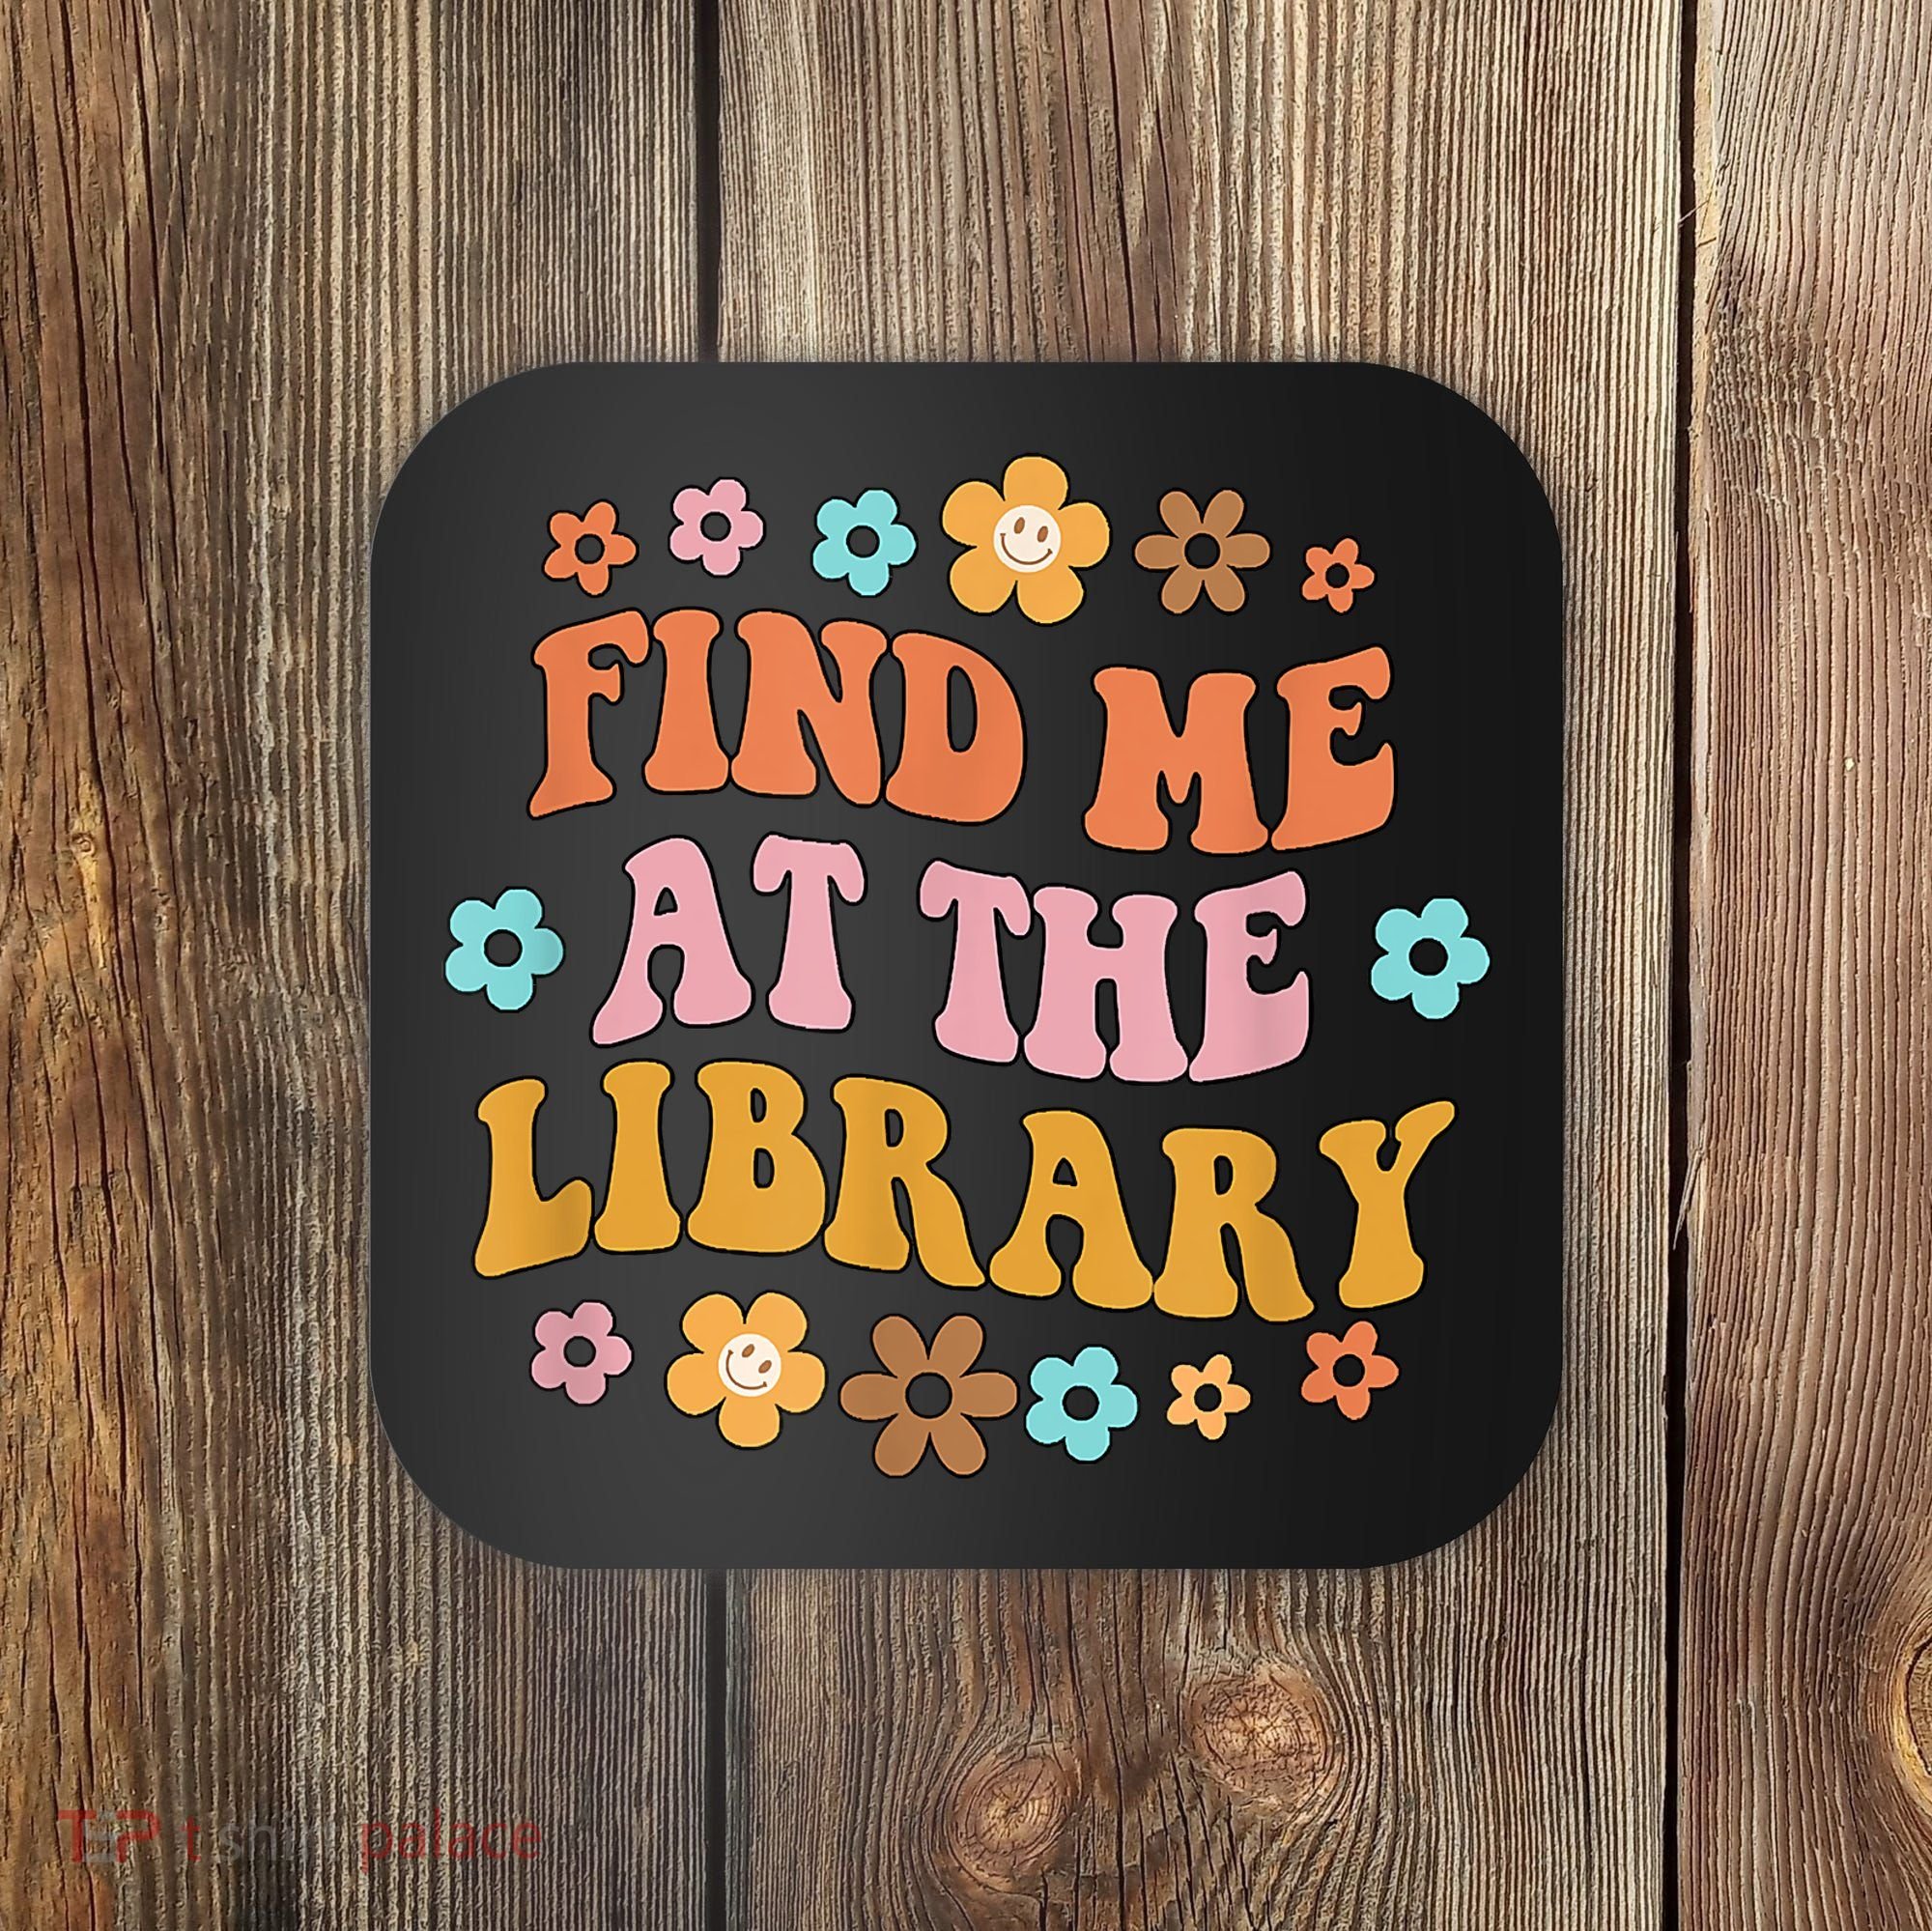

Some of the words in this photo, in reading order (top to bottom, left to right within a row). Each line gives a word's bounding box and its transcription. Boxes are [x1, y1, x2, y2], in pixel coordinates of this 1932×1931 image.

[528, 608, 1025, 824] FIND
[1082, 645, 1396, 855] ME
[592, 837, 865, 1044] AT
[920, 863, 1310, 1082] THE
[473, 1059, 1457, 1323] LIBRARY
